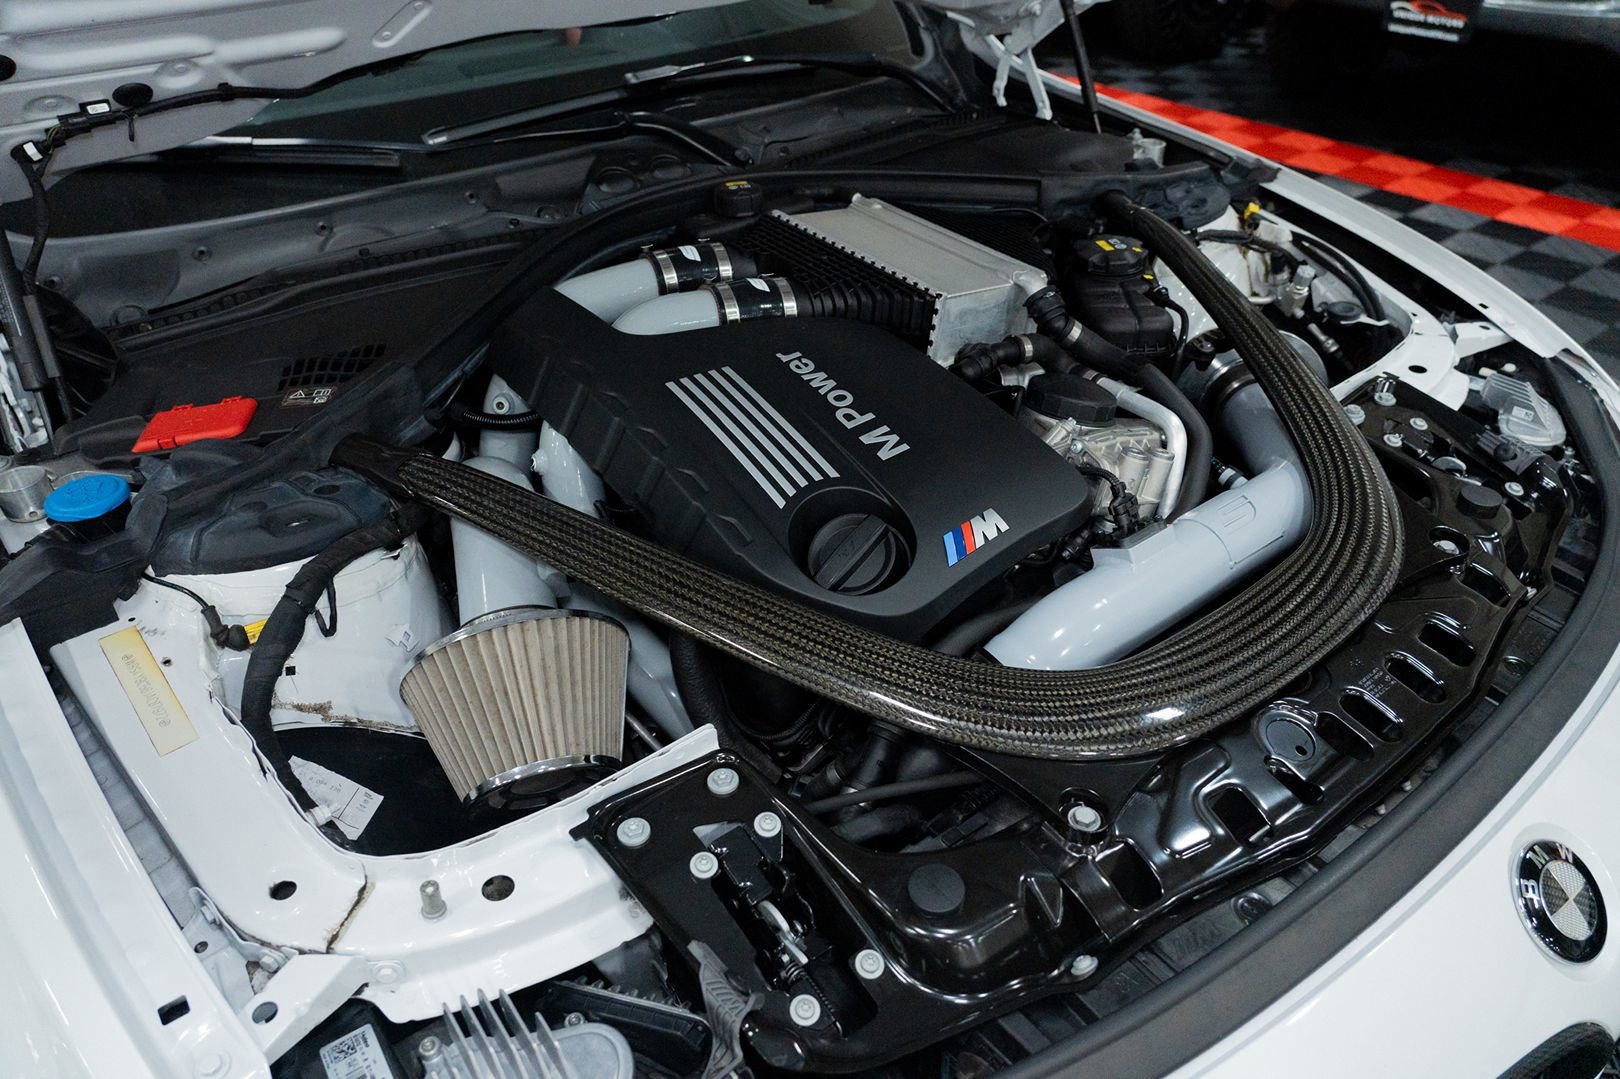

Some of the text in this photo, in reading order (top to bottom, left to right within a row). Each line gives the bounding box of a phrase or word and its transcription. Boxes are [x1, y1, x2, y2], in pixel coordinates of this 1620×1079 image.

[776, 351, 911, 461] M Power
[1520, 843, 1573, 901] BMW
